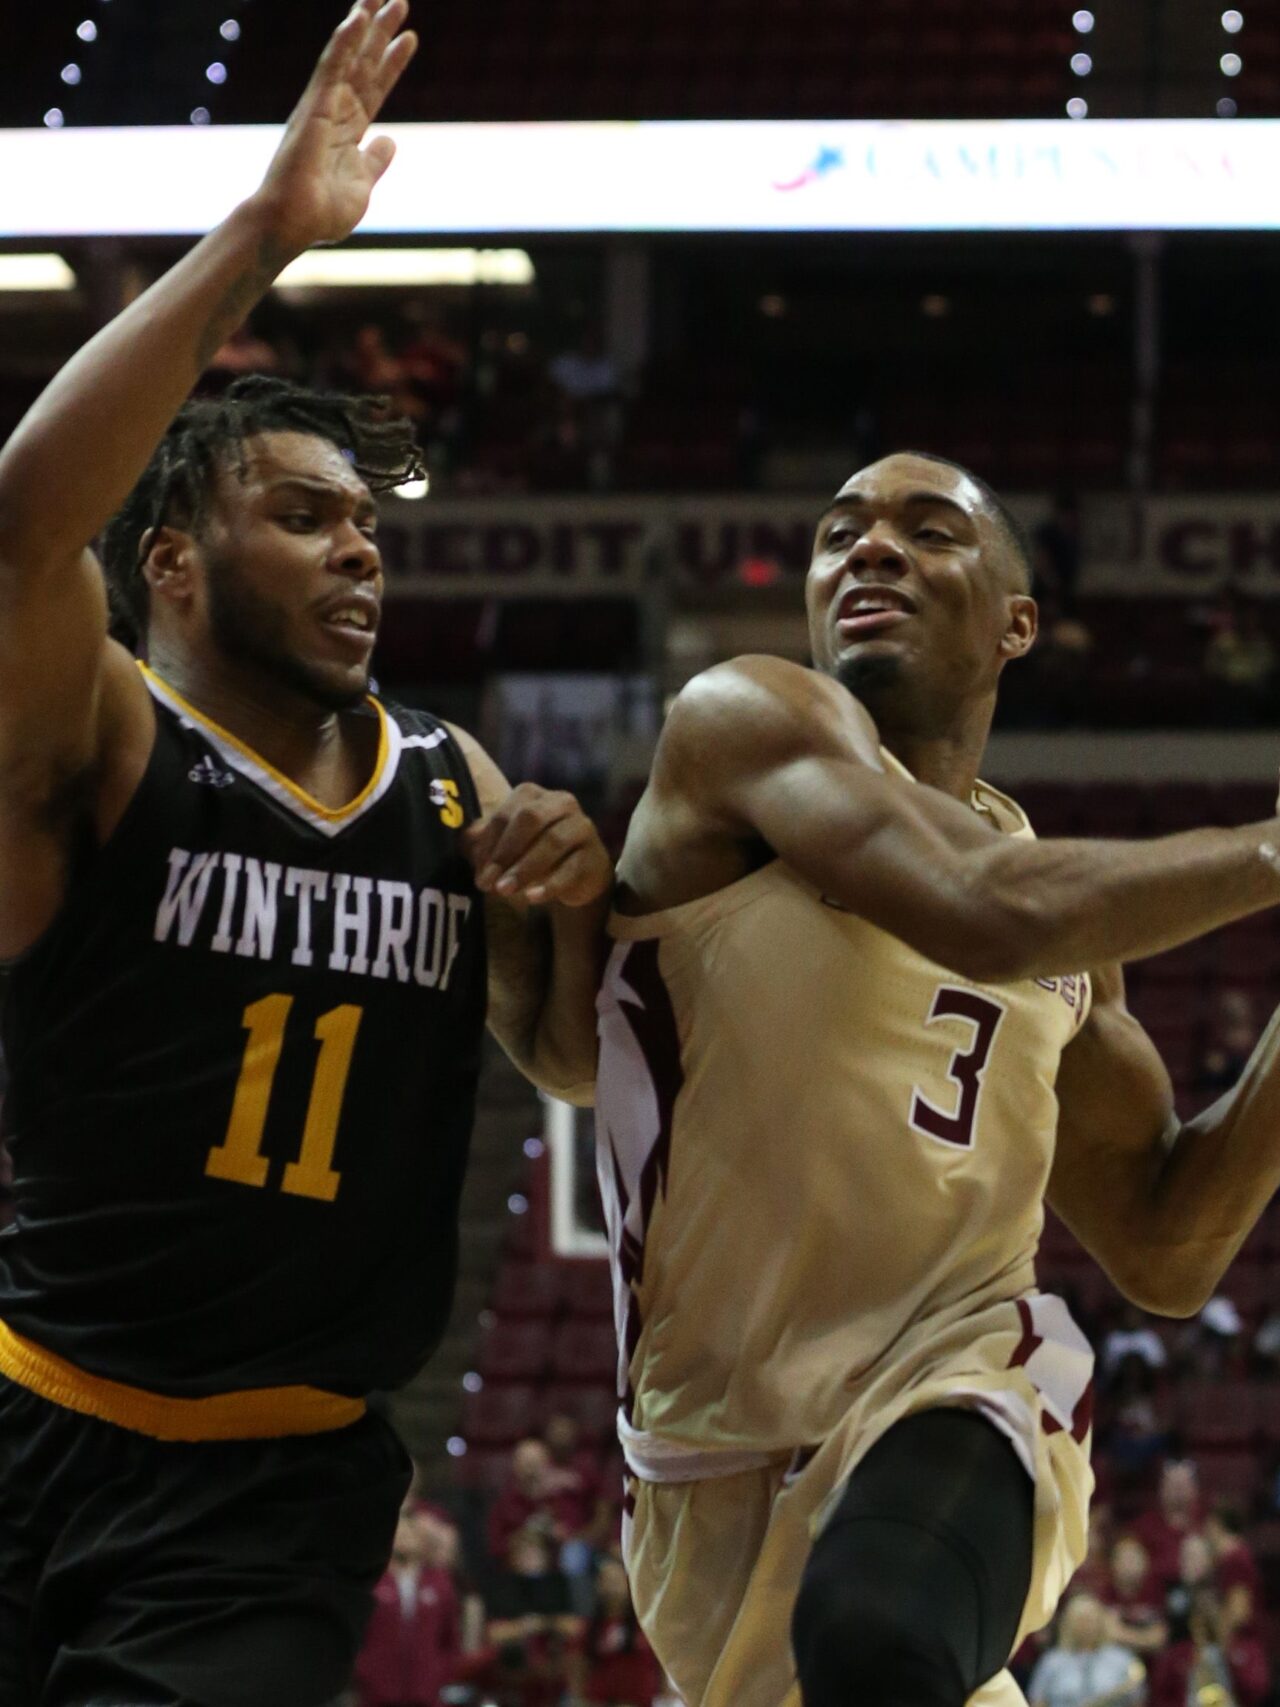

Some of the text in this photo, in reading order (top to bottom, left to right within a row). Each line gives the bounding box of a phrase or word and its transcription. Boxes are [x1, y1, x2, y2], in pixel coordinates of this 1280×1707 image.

[378, 523, 643, 573] REDIT
[204, 992, 363, 1202] 11
[908, 983, 1007, 1148] 3
